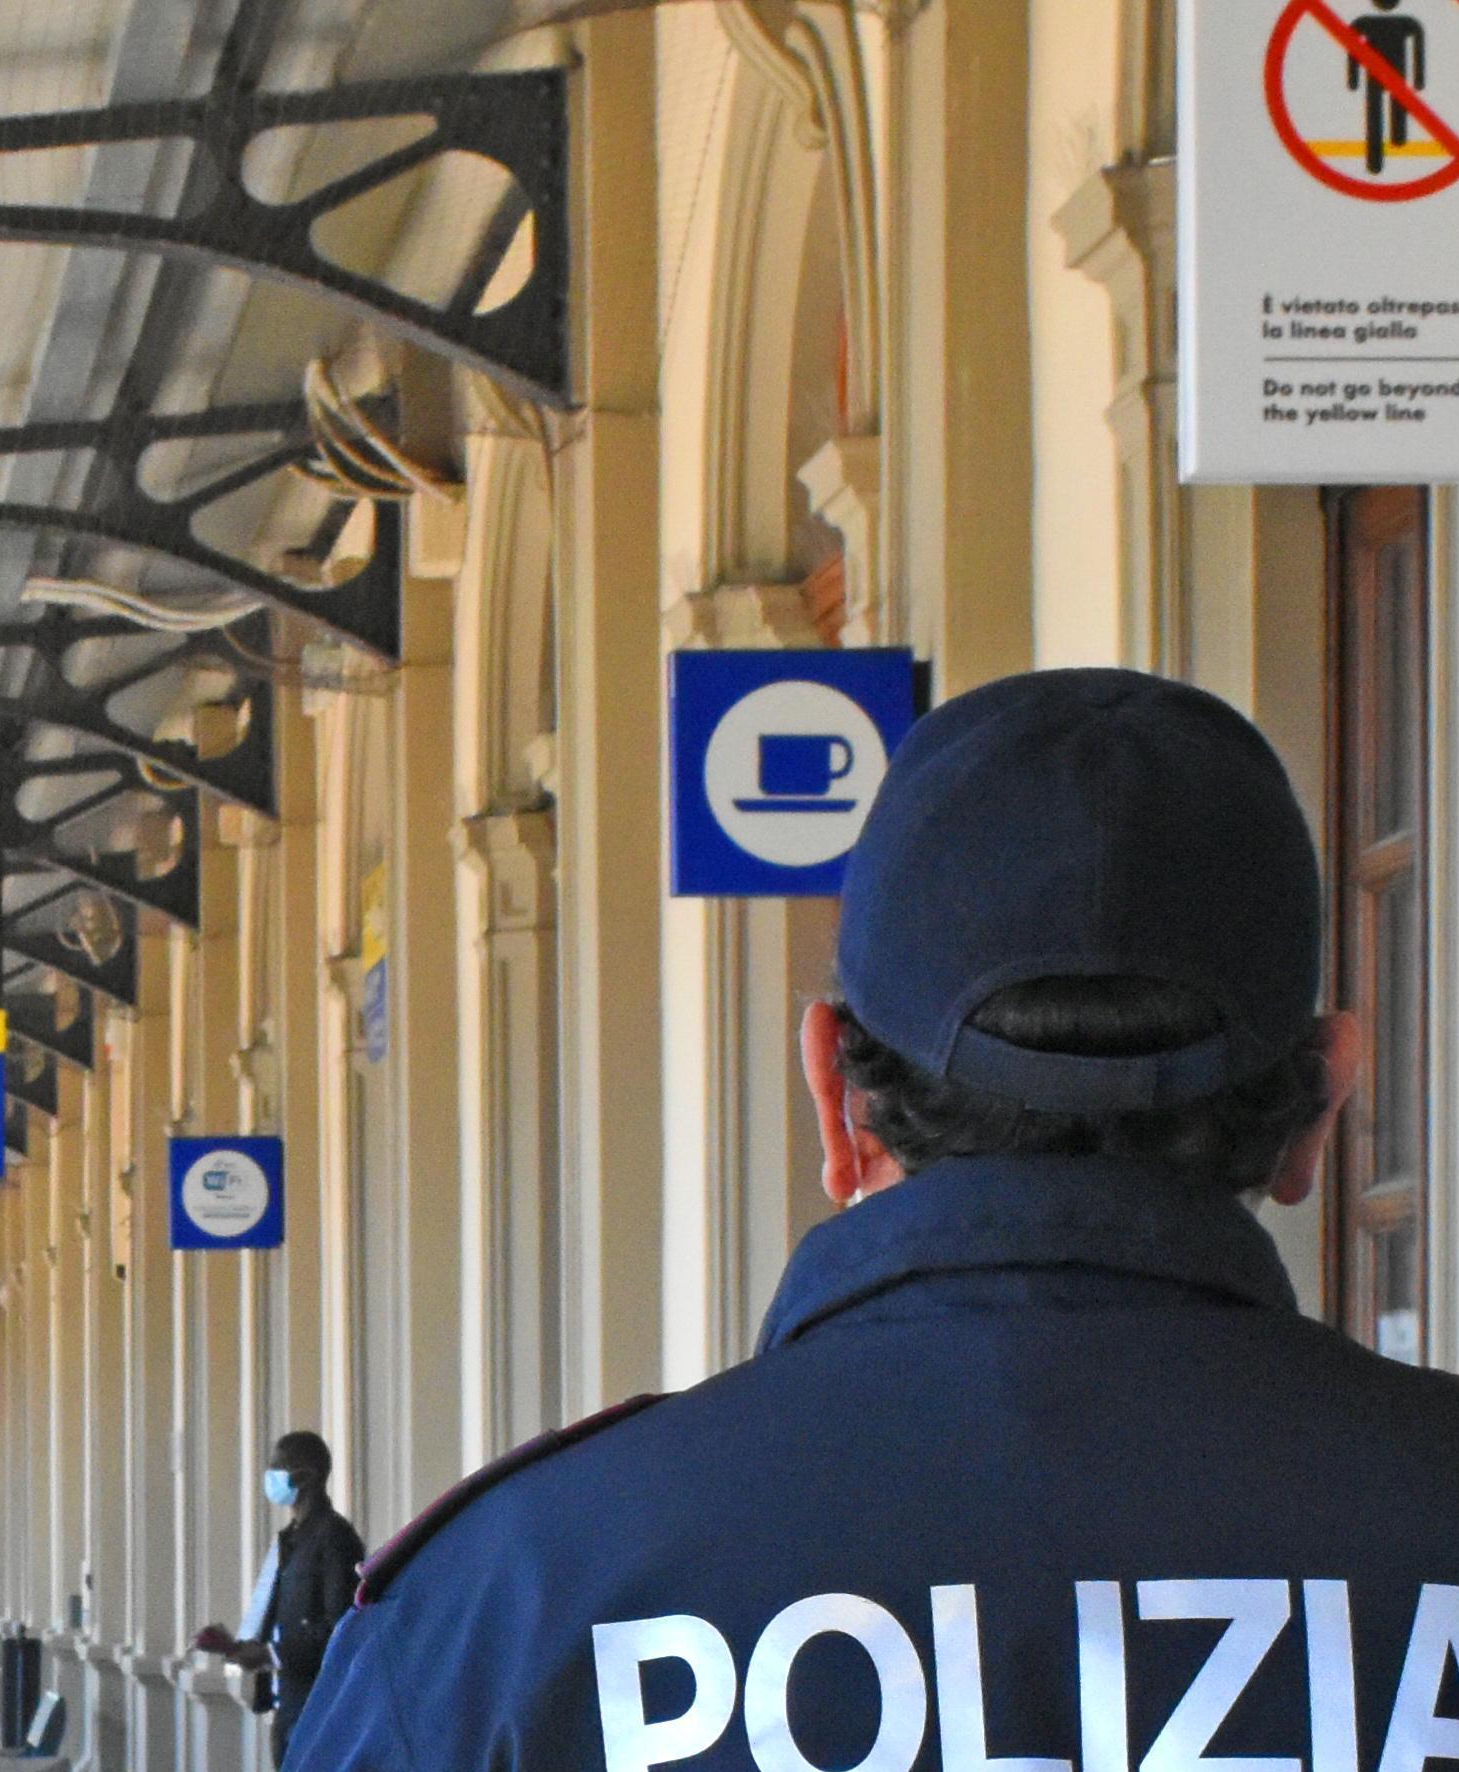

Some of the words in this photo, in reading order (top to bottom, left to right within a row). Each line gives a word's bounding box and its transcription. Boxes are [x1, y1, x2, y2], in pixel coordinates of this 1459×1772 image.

[1282, 296, 1360, 315] vietato
[1262, 320, 1283, 339] la
[1290, 320, 1347, 339] linea
[1263, 378, 1293, 397] Do
[1300, 381, 1336, 397] not
[1343, 383, 1372, 401] go
[1263, 403, 1298, 421] the
[1305, 403, 1378, 426] yellow
[1385, 403, 1427, 421] line
